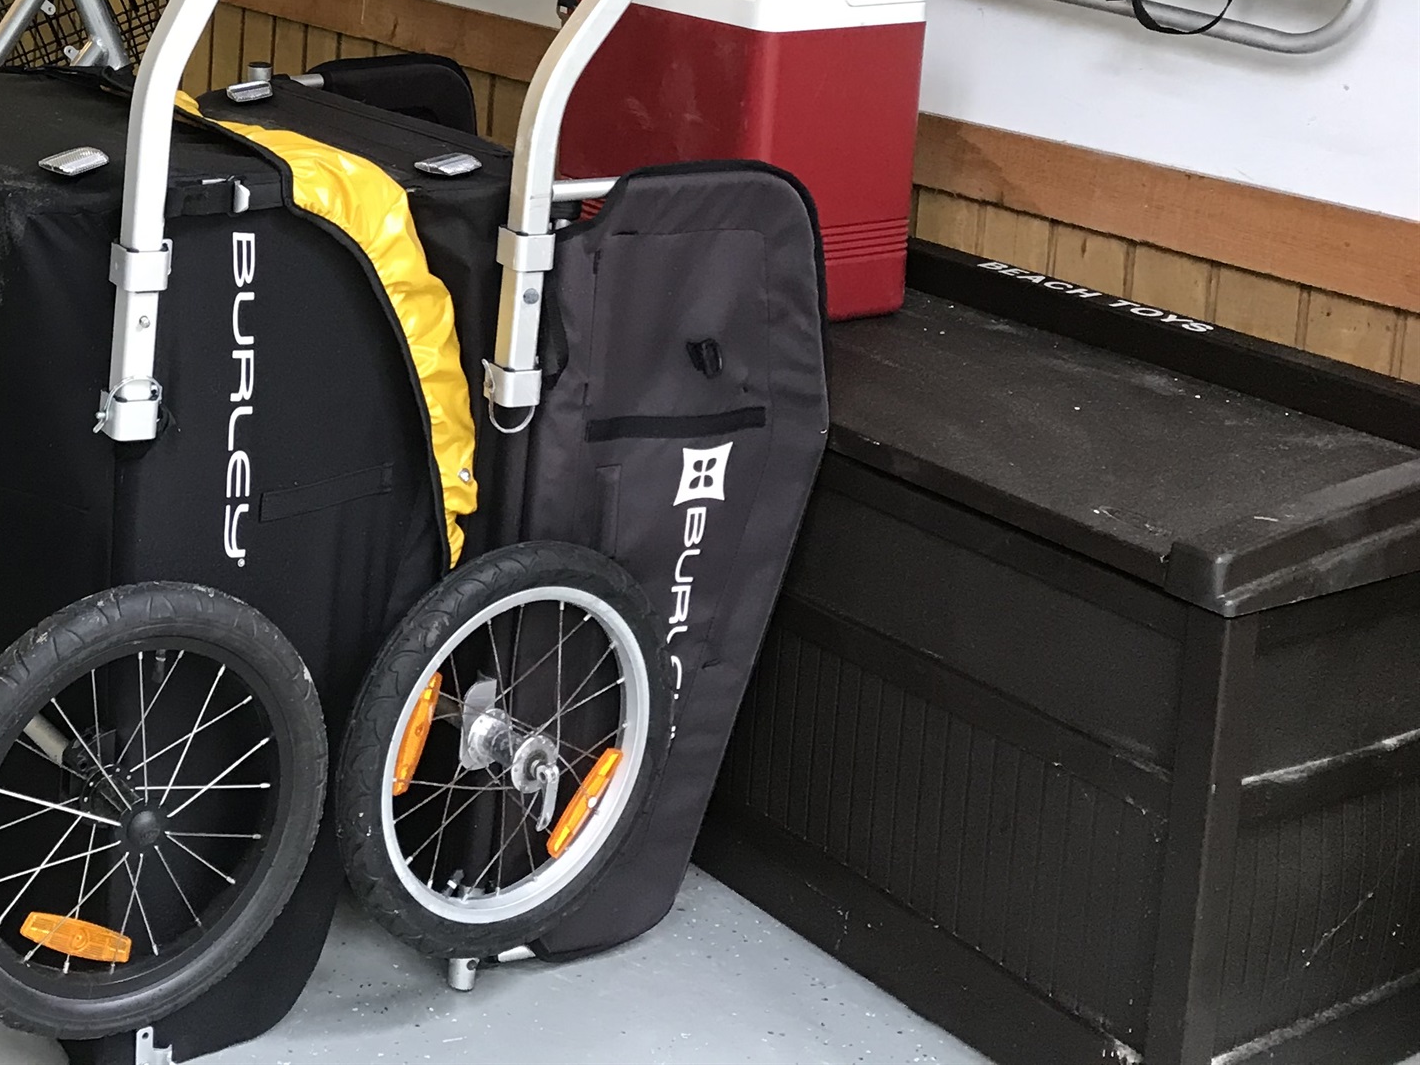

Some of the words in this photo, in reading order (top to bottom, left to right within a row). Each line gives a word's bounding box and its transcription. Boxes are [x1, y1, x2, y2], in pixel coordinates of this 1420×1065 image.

[223, 231, 256, 560] BURLEY
[976, 260, 1103, 300] BEACH
[1108, 298, 1216, 334] TOYS
[666, 506, 707, 739] BURL
